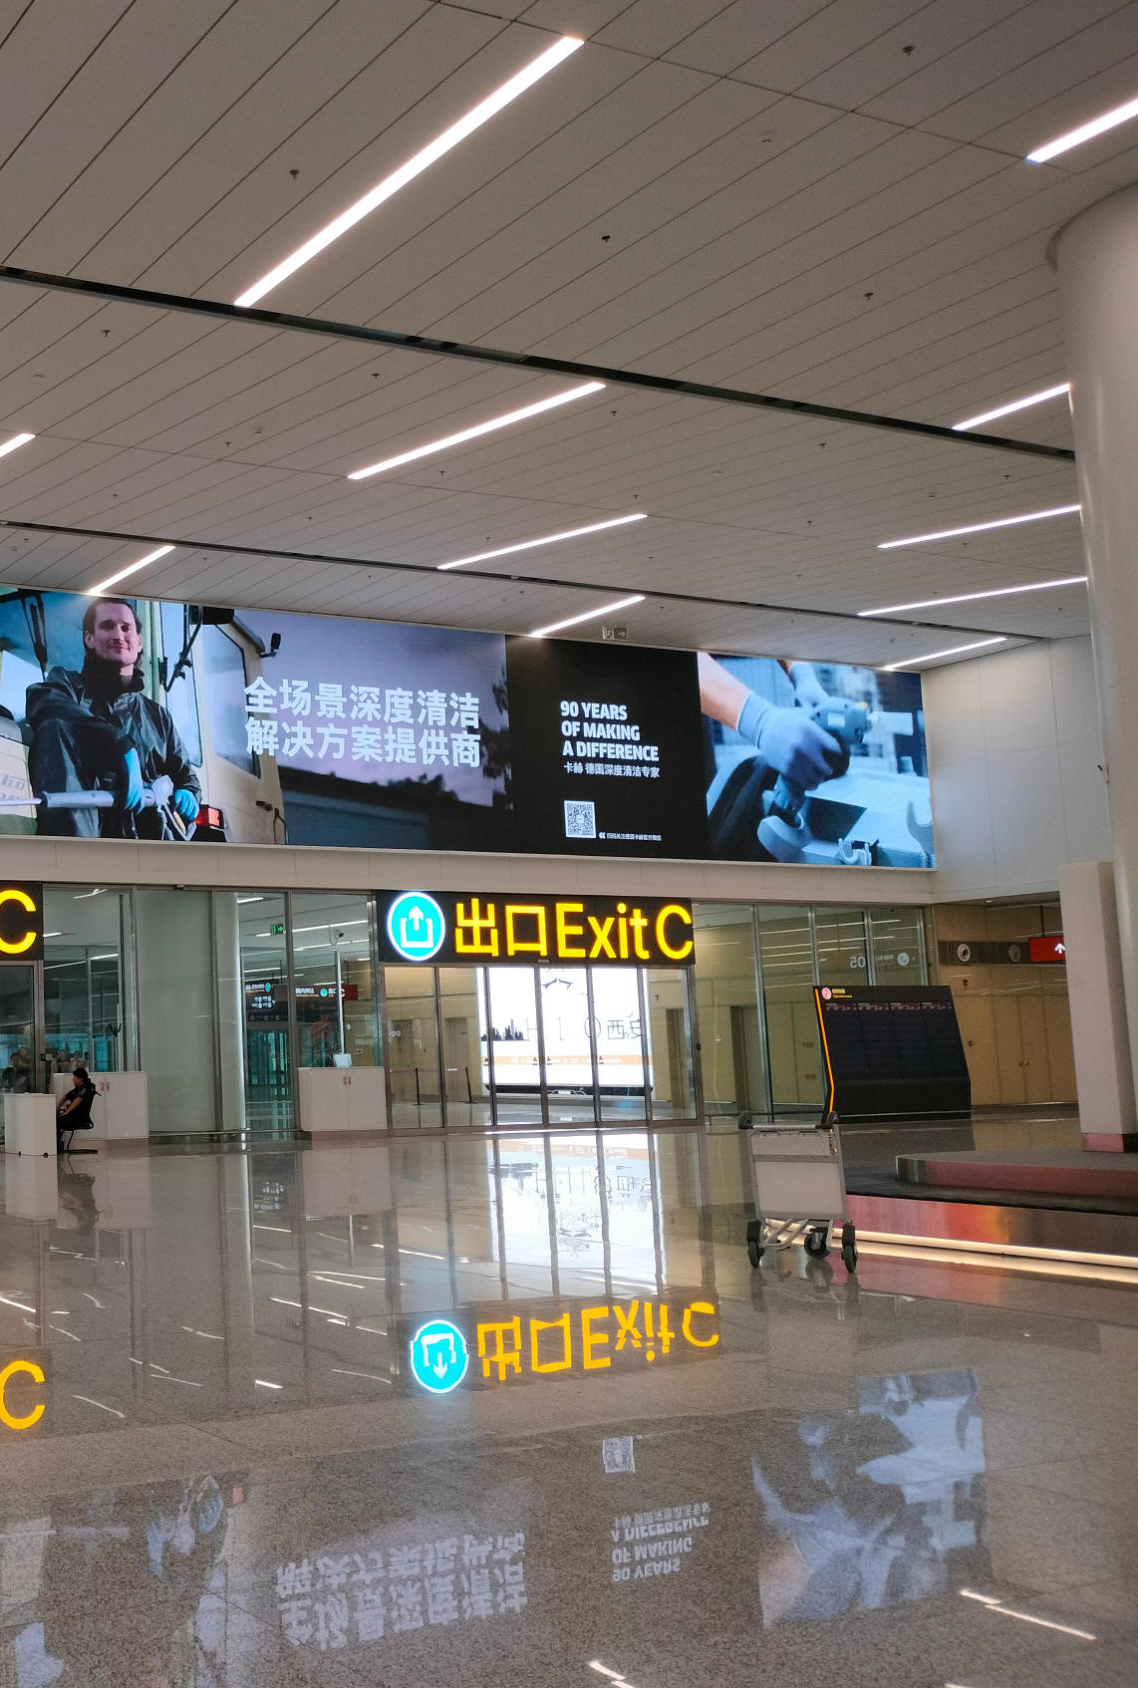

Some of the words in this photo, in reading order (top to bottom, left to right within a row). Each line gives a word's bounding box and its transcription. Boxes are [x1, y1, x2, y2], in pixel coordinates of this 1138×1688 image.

[244, 676, 480, 728] 全场景深度清洁
[560, 700, 579, 718] 90
[581, 702, 628, 721] YEARS
[244, 716, 481, 768] 解决方案提供商
[561, 721, 581, 737] OF
[584, 723, 641, 741] MAKING
[562, 740, 574, 757] A
[576, 742, 660, 762] DIFFERENCE
[454, 897, 548, 957] 出口
[556, 901, 650, 959] Exit
[656, 904, 693, 959] C
